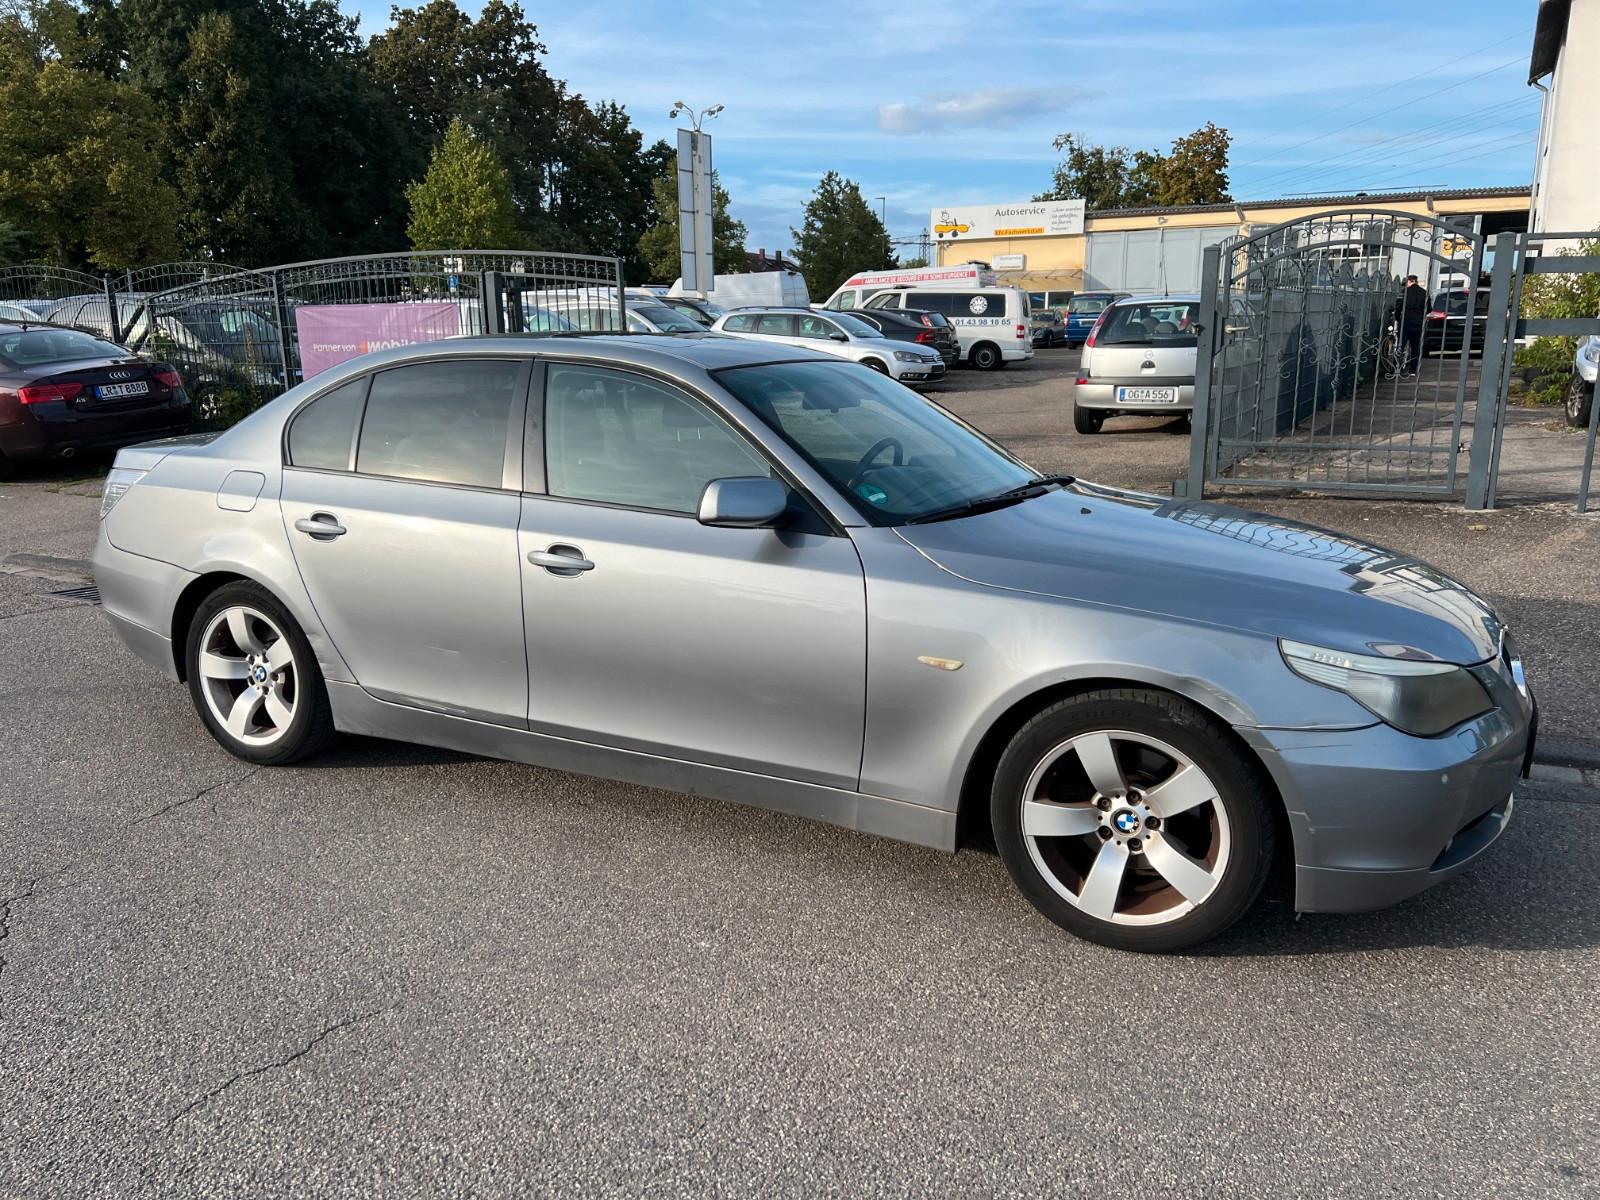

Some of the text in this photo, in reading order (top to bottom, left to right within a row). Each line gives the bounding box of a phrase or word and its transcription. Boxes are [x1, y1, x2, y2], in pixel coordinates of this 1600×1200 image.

[995, 206, 1046, 216] Autoservice
[313, 343, 340, 352] Partner
[341, 344, 356, 352] von
[100, 386, 113, 397] LR
[126, 382, 148, 394] 8888
[1128, 390, 1169, 399] OG A 556
